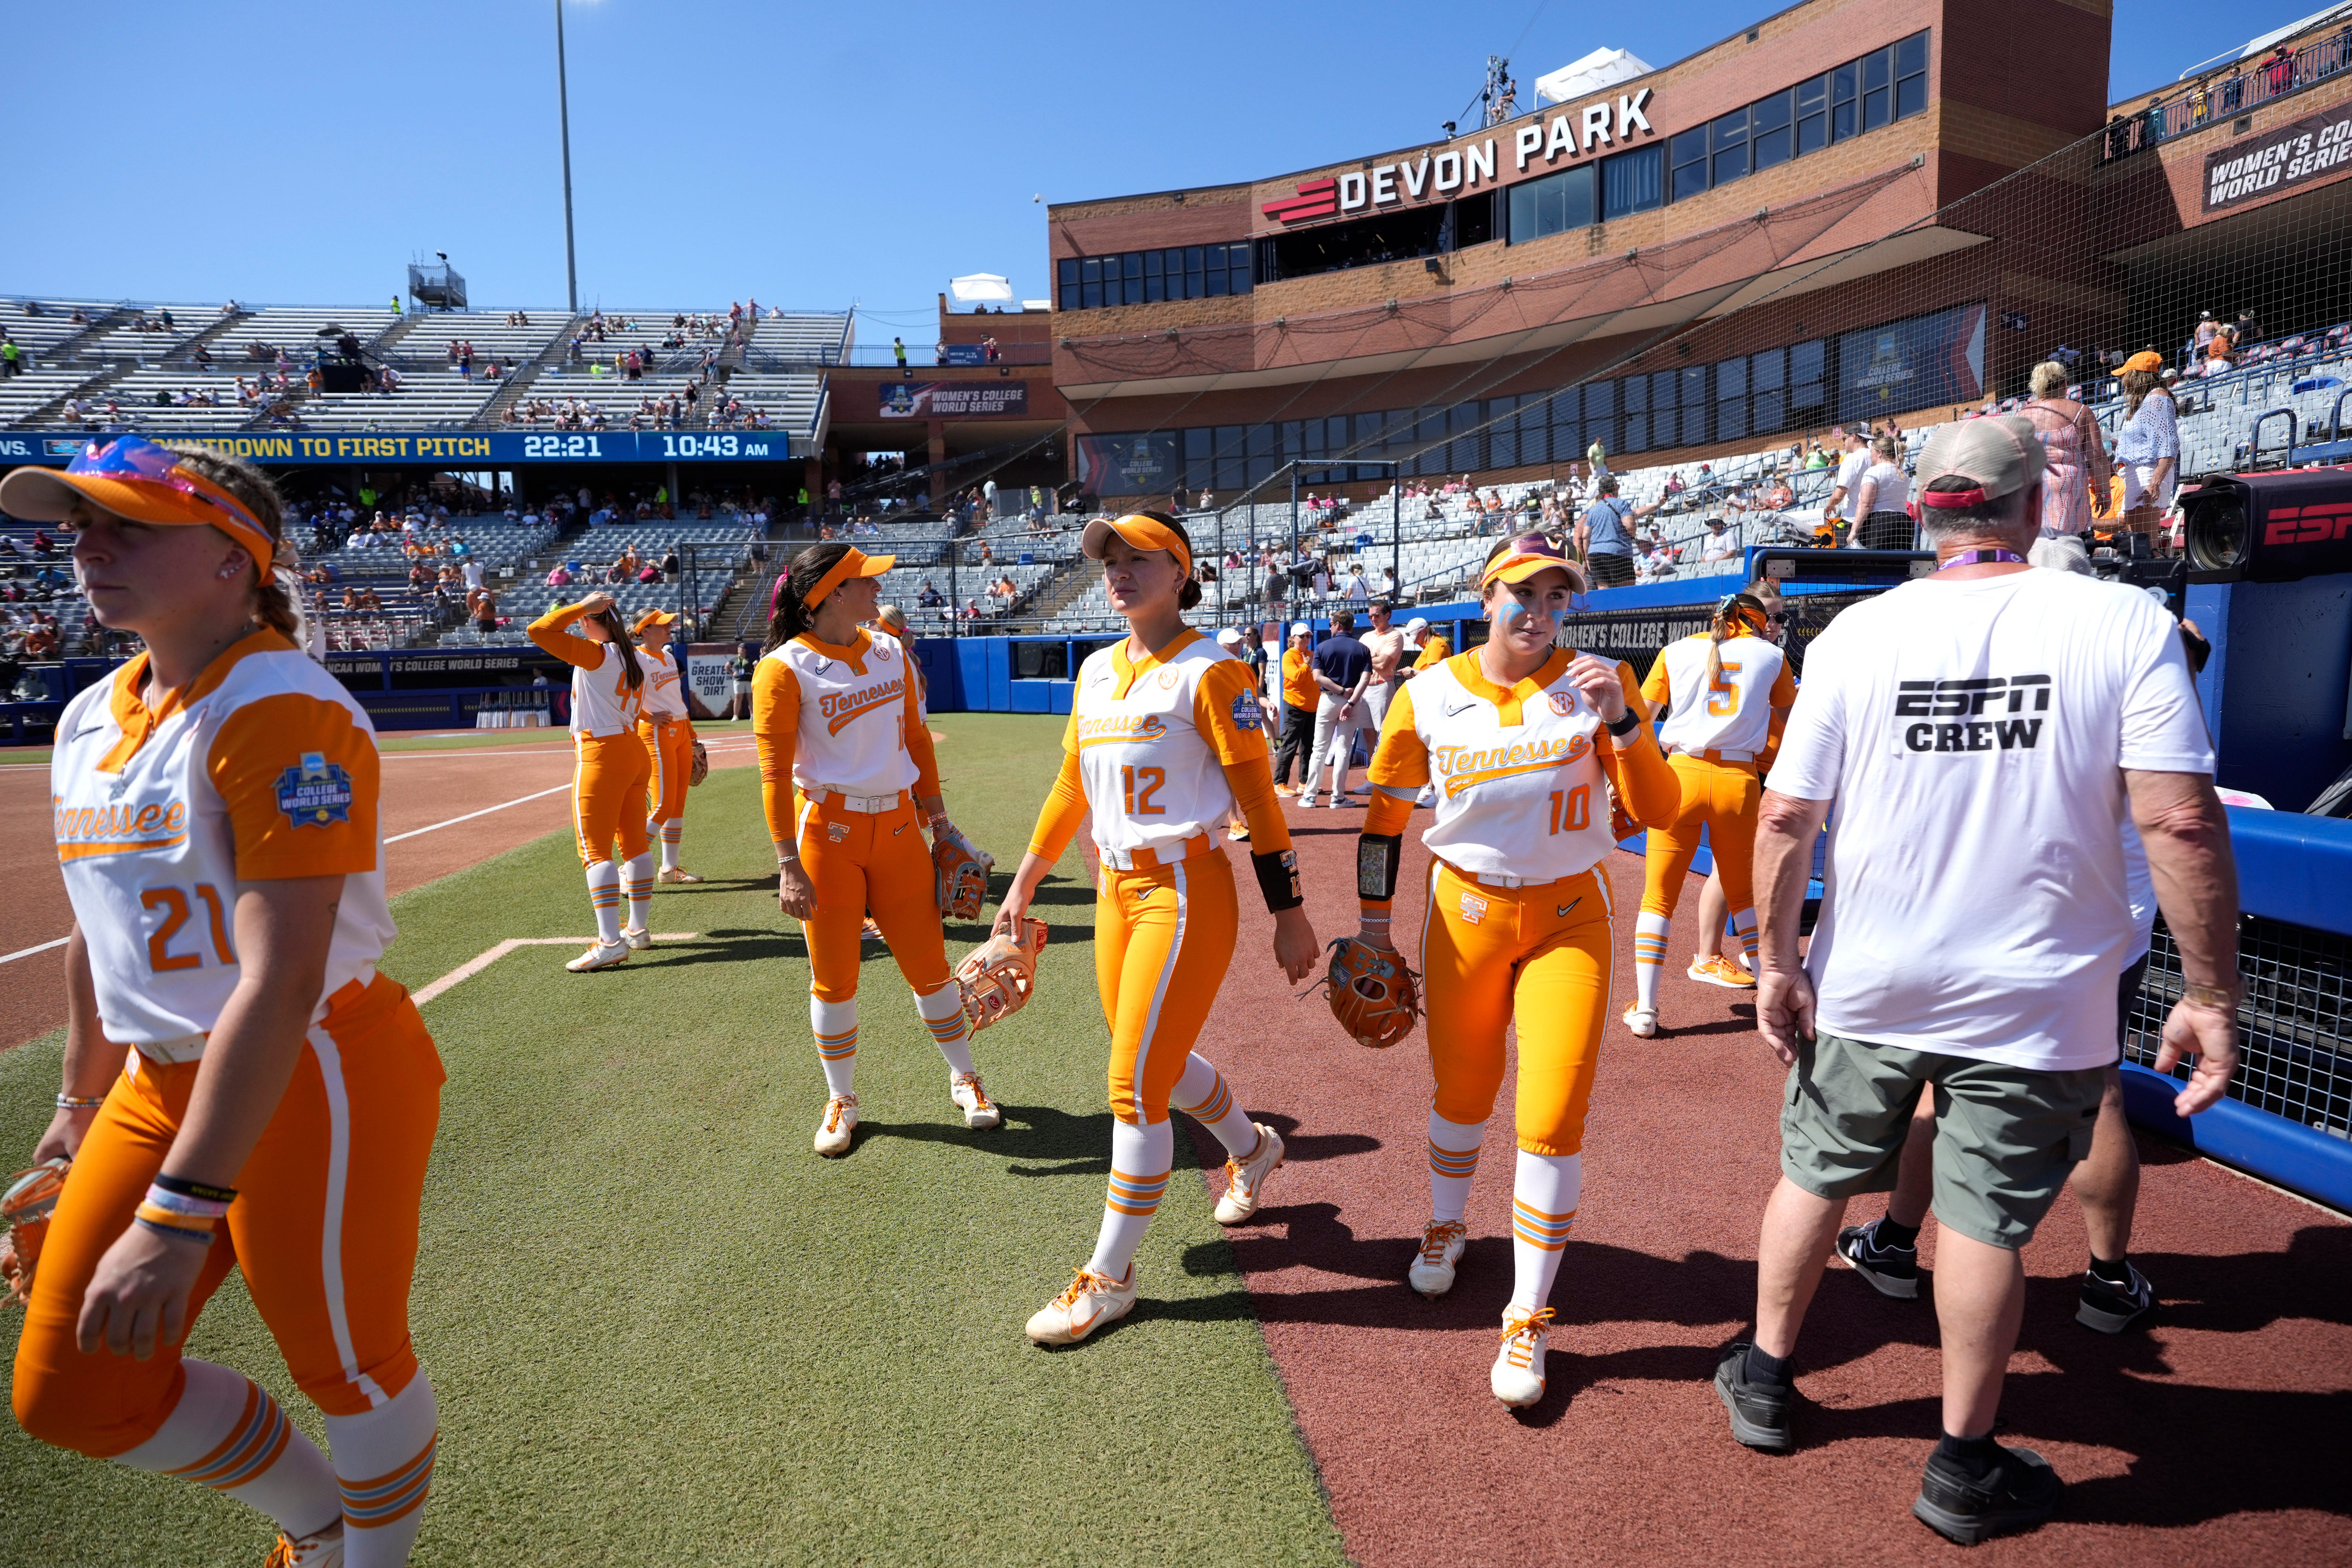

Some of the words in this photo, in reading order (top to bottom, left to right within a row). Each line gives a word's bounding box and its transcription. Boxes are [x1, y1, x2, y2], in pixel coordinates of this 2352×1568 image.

[1340, 138, 1494, 209] DEVON
[1516, 88, 1651, 168] PARK
[2211, 133, 2312, 185] WOMEN'S
[2210, 165, 2281, 205] WORLD
[1857, 374, 1884, 388] WORLD
[1885, 369, 1914, 382] SERIES
[1868, 362, 1902, 377] COLLEGE
[932, 391, 979, 401] WOMEN'S
[982, 390, 1023, 400] COLLEGE
[932, 402, 966, 412] WORLD
[969, 401, 1005, 411] SERIES
[299, 438, 330, 456] TO
[339, 438, 406, 456] FIRST
[417, 438, 490, 456] PITCH
[524, 436, 638, 457] 22:21
[663, 436, 738, 457] 10:43
[745, 444, 768, 456] AM
[1556, 624, 1607, 648] WOMEN'S
[1610, 622, 1664, 648] COLLEGE
[327, 663, 353, 673] NCAA
[405, 660, 446, 671] COLLEGE
[447, 659, 481, 670] WORLD
[484, 658, 519, 669] SERIES
[691, 665, 731, 675] GREATE
[696, 676, 725, 686] SHOW
[704, 686, 725, 696] DIRT
[1707, 662, 1742, 717] 5
[819, 678, 905, 718] Tennessee
[1550, 693, 1574, 715] SEC
[1895, 674, 2051, 716] ESPN
[1905, 718, 2042, 752] CREW
[1436, 734, 1585, 776] Tennessee
[281, 796, 319, 809] WORLD
[320, 793, 350, 805] SERIES
[296, 784, 338, 797] COLLEGE
[1121, 765, 1165, 815] 12
[1549, 783, 1590, 836] 10
[138, 883, 237, 972] 21
